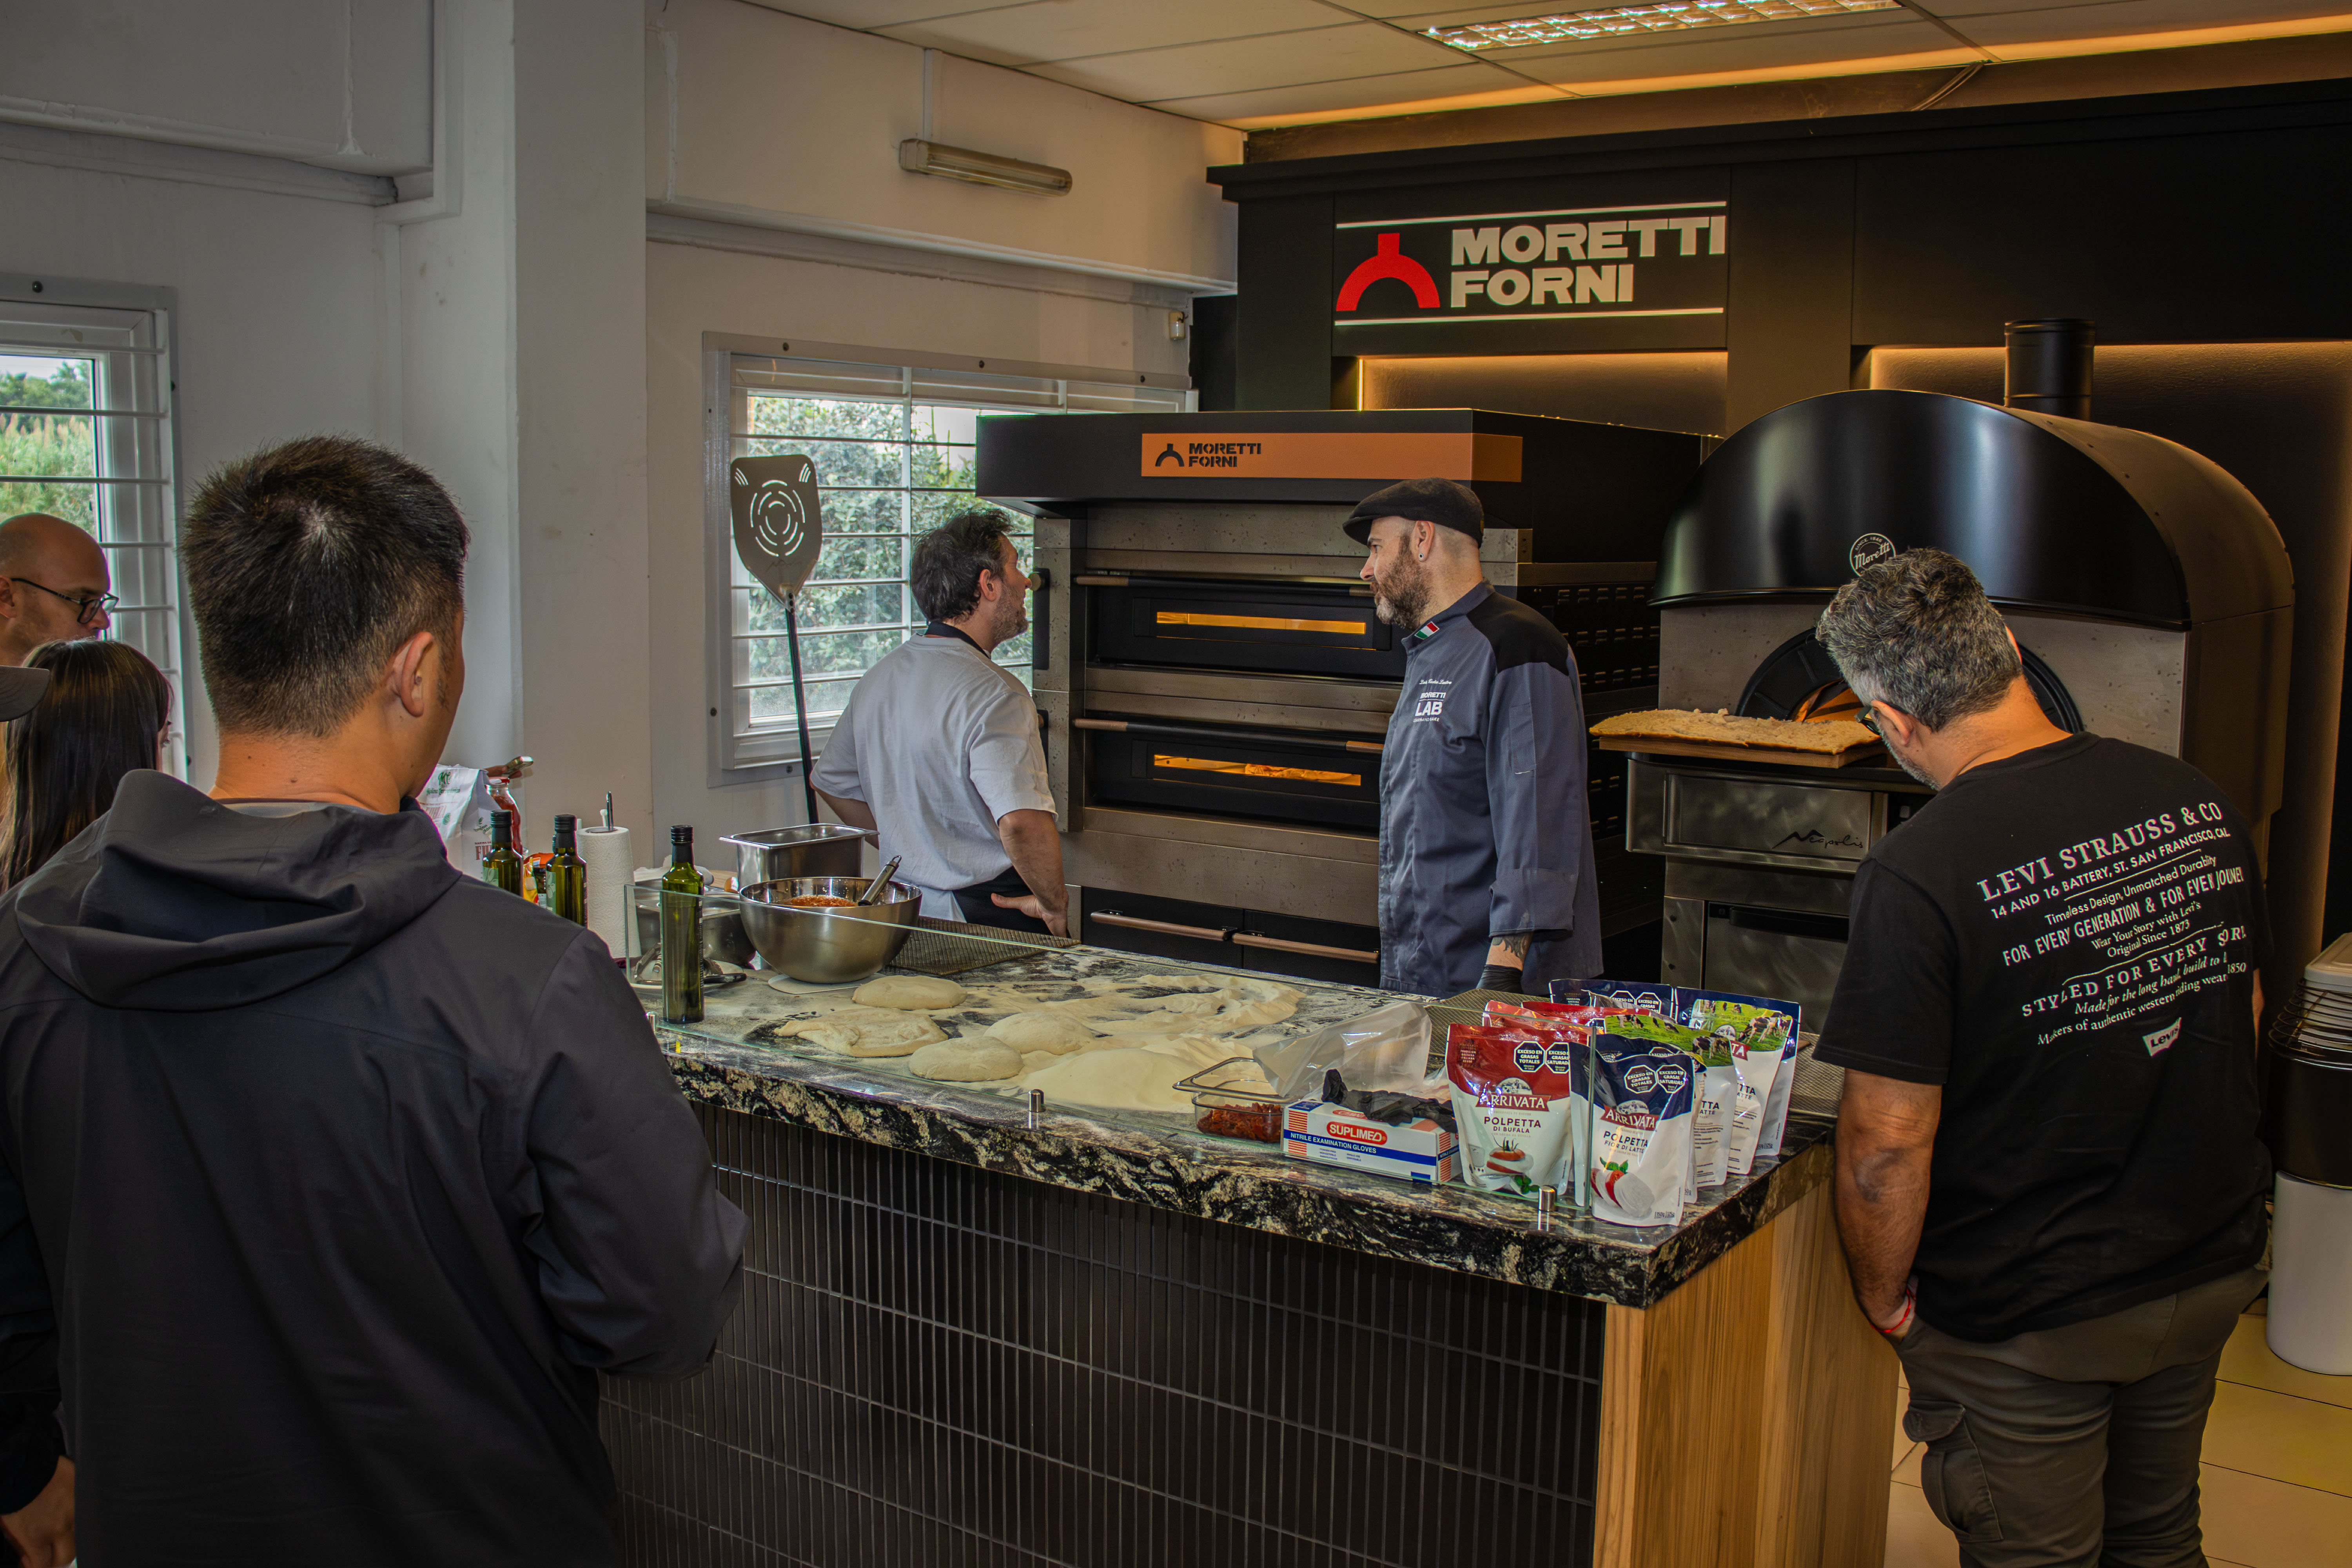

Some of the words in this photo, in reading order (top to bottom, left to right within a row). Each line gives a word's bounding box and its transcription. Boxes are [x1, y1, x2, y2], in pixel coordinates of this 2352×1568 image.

[1451, 215, 1726, 266] MORETTI
[1451, 264, 1633, 308] FORNI
[1189, 443, 1261, 454] MORETTI
[1189, 456, 1237, 467] FORNI
[1853, 542, 1891, 570] Moretti
[1415, 701, 1443, 717] LAB
[1772, 829, 1863, 849] Neapolis
[1977, 857, 2054, 902] LEVI
[2059, 814, 2176, 870] STRAUSS
[2180, 807, 2200, 826] &
[2198, 802, 2223, 822] CO
[1991, 905, 2007, 919] 14
[2011, 893, 2040, 913] AND
[2043, 886, 2060, 899] 16
[2062, 866, 2112, 892] BATTERY,
[2113, 861, 2129, 873] ST.
[2130, 849, 2157, 867] SAN
[2044, 904, 2089, 925] Timeless
[2089, 892, 2123, 909] Design,
[2123, 867, 2180, 897] Unmatched
[2002, 944, 2032, 966] FOR
[2034, 927, 2070, 955] EVERY
[2073, 902, 2141, 938] GENERATION
[2145, 897, 2156, 913] &
[2160, 886, 2185, 908] FOR
[2187, 873, 2215, 897] EVER
[2091, 937, 2112, 949] Wear
[2113, 929, 2133, 942] Your
[2132, 921, 2155, 935] Story
[2156, 911, 2179, 926] with
[2180, 900, 2202, 917] Levi's
[2107, 936, 2142, 957] Original
[2141, 931, 2167, 945] Since
[2169, 919, 2190, 935] 1873
[2022, 981, 2100, 1017] STYLED
[2105, 965, 2143, 990] FOR
[2147, 937, 2207, 973] EVERY
[2074, 999, 2106, 1014] Made
[2105, 994, 2120, 1012] for
[2122, 988, 2137, 1002] the
[2138, 981, 2158, 996] long
[2183, 956, 2208, 975] build
[2209, 957, 2220, 967] to
[2075, 1018, 2089, 1031] of
[2091, 1011, 2136, 1030] authentic
[2138, 993, 2175, 1013] western
[2175, 980, 2201, 996] riding
[2201, 974, 2228, 984] wear
[2227, 962, 2247, 975] 1850
[1479, 1094, 1545, 1109] ARRIVATA
[1484, 1116, 1541, 1128] POLPETTA
[1606, 1109, 1655, 1128] ARRIVATA
[1291, 1132, 1312, 1142] NITRILE
[1313, 1136, 1352, 1149] EXAMINATION
[1353, 1144, 1377, 1154] GLOVES
[1329, 1124, 1382, 1142] SUPLIMED
[1603, 1131, 1648, 1147] POLPETTA
[1604, 1140, 1620, 1149] FIOR
